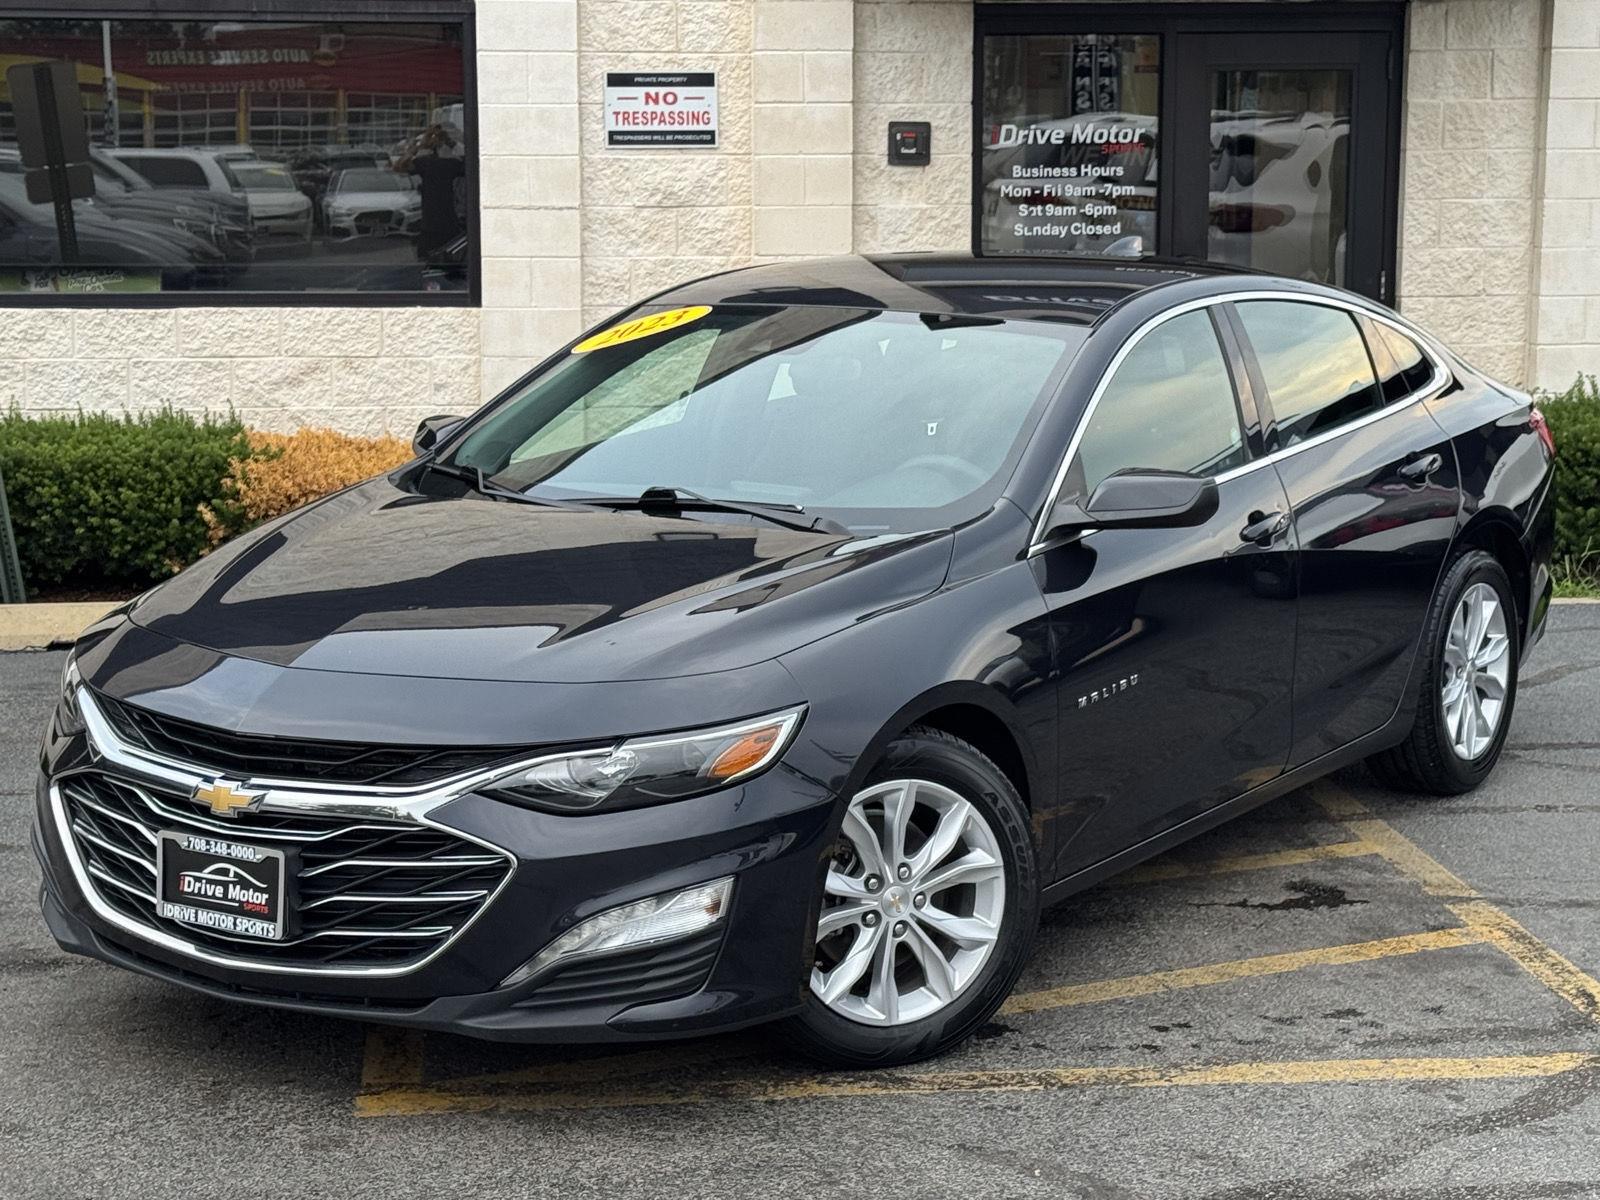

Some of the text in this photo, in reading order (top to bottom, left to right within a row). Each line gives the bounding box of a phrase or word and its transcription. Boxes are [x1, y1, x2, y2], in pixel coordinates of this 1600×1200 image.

[644, 91, 678, 106] NO
[612, 110, 711, 127] TRESPASSING
[991, 122, 1146, 145] iDrive Motor
[1101, 142, 1146, 155] SPORTS
[1012, 163, 1124, 178] Business Hours
[1000, 184, 1032, 198] Mon
[1064, 184, 1096, 197] 9am
[1045, 203, 1077, 217] 9am
[1070, 222, 1122, 236] Closed
[593, 310, 690, 346] 2023
[1078, 674, 1139, 710] MALIBU
[188, 836, 256, 860] 708-348-0000
[179, 875, 269, 906] iDrive Motor
[243, 902, 269, 914] SPORTS
[198, 910, 234, 931] MOTOR
[236, 917, 275, 938] SPORTS
